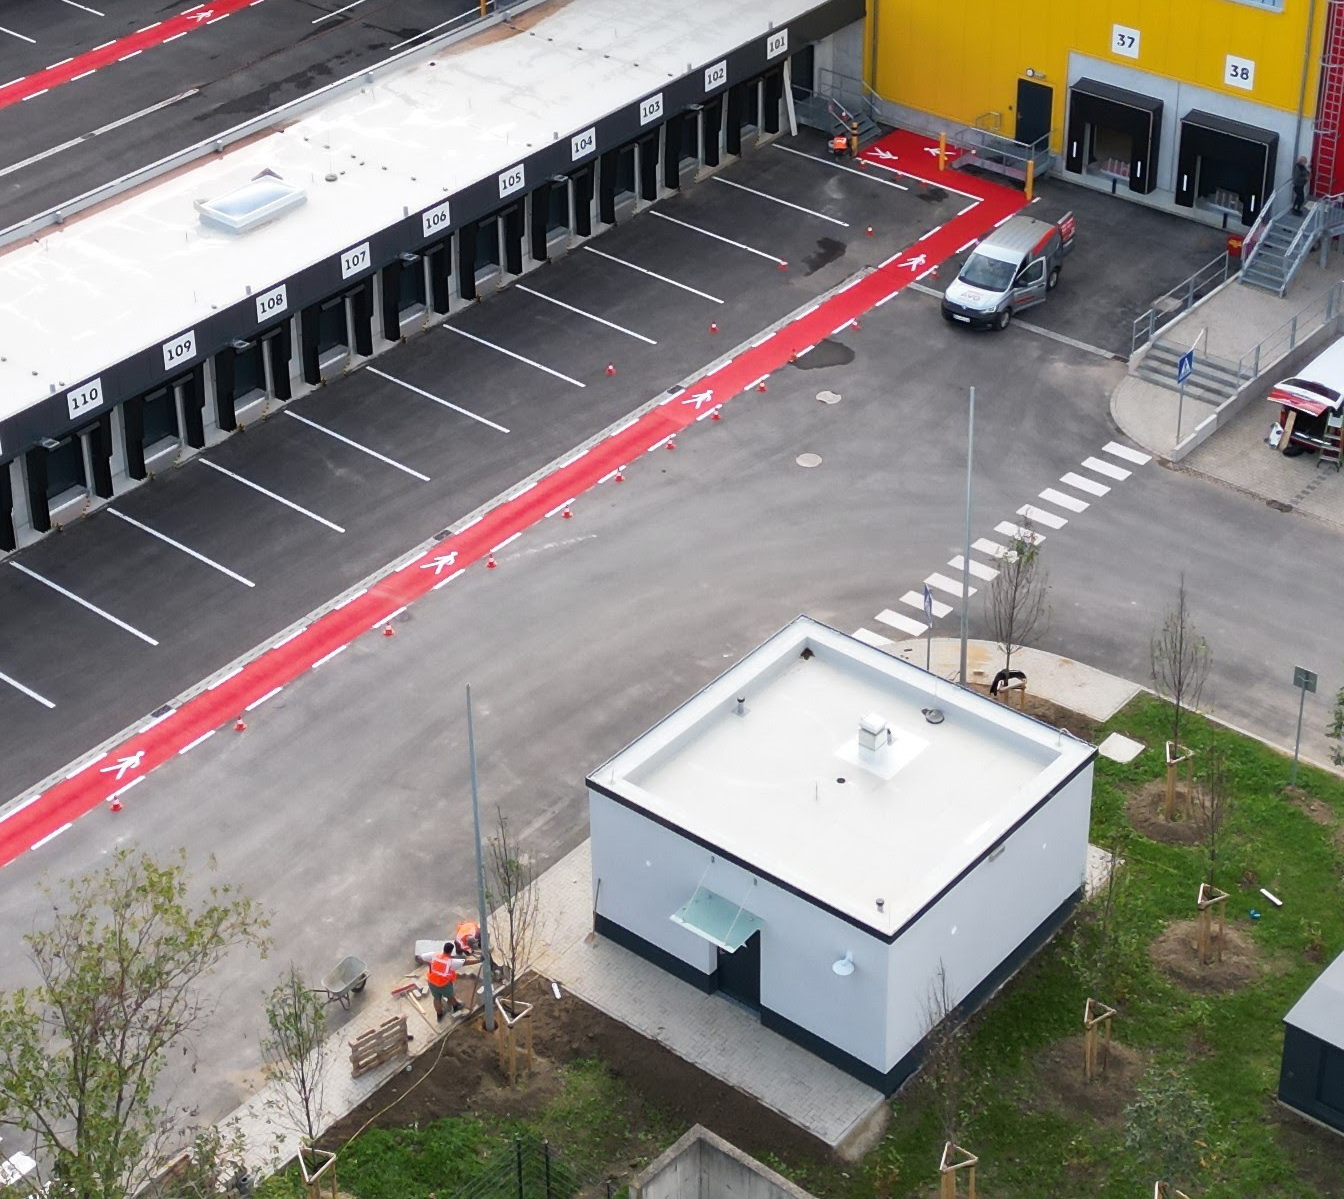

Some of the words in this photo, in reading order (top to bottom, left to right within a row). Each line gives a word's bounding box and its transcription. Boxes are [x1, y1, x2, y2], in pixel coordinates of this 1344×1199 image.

[769, 36, 785, 53] 101
[1116, 33, 1136, 49] 37
[707, 67, 724, 85] 102
[1229, 64, 1250, 81] 38
[643, 100, 661, 118] 103
[574, 135, 593, 154] 104
[502, 171, 522, 191] 105
[426, 210, 447, 230] 106
[345, 250, 366, 271] 107
[260, 293, 284, 314] 108
[167, 339, 192, 361] 109
[72, 387, 99, 410] 110
